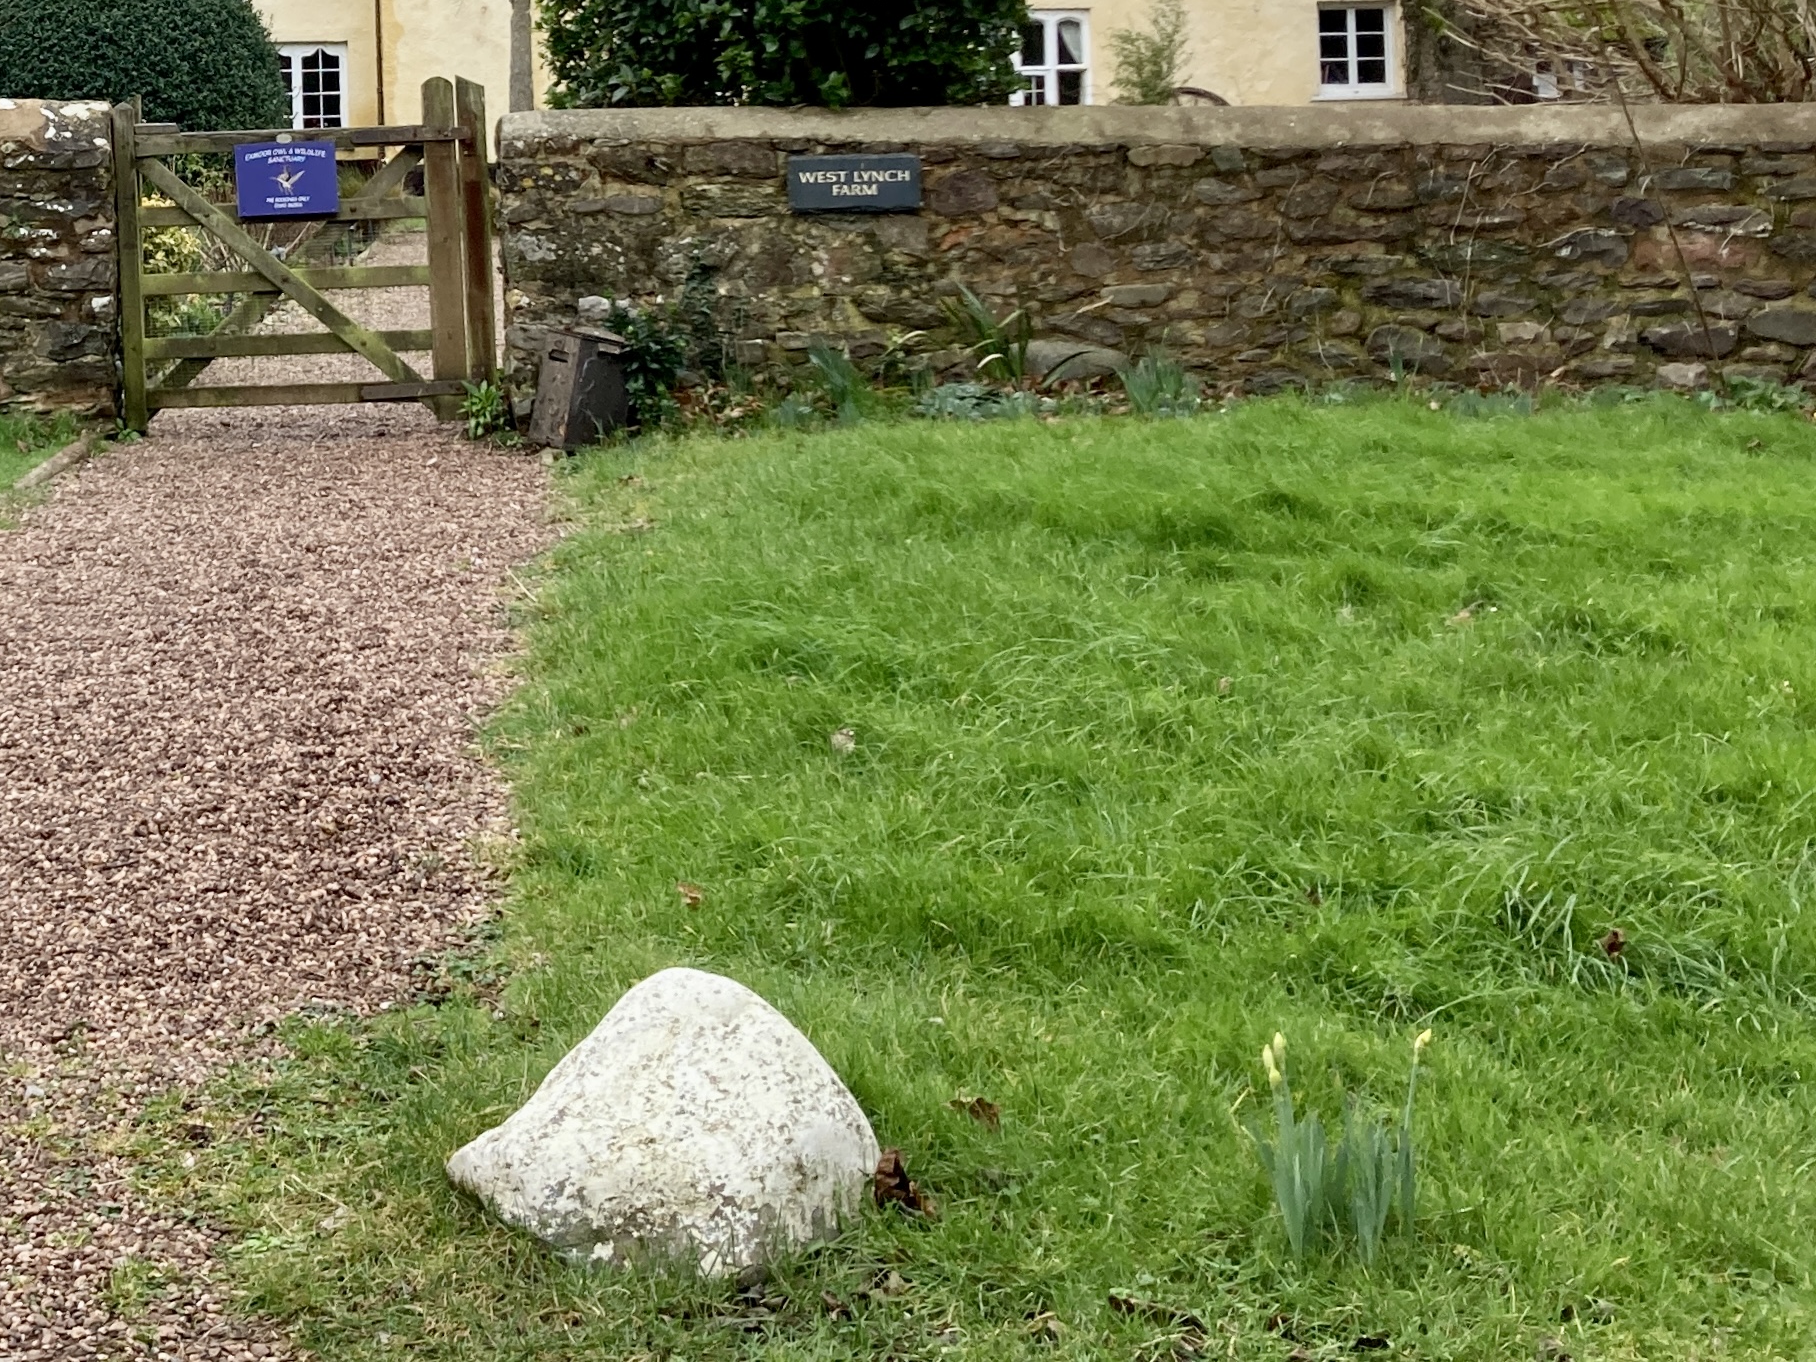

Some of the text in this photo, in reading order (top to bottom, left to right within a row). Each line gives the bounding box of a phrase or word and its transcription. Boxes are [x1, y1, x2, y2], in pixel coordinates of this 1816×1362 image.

[798, 170, 911, 183] WEST LYNCH
[832, 184, 878, 196] FARM
